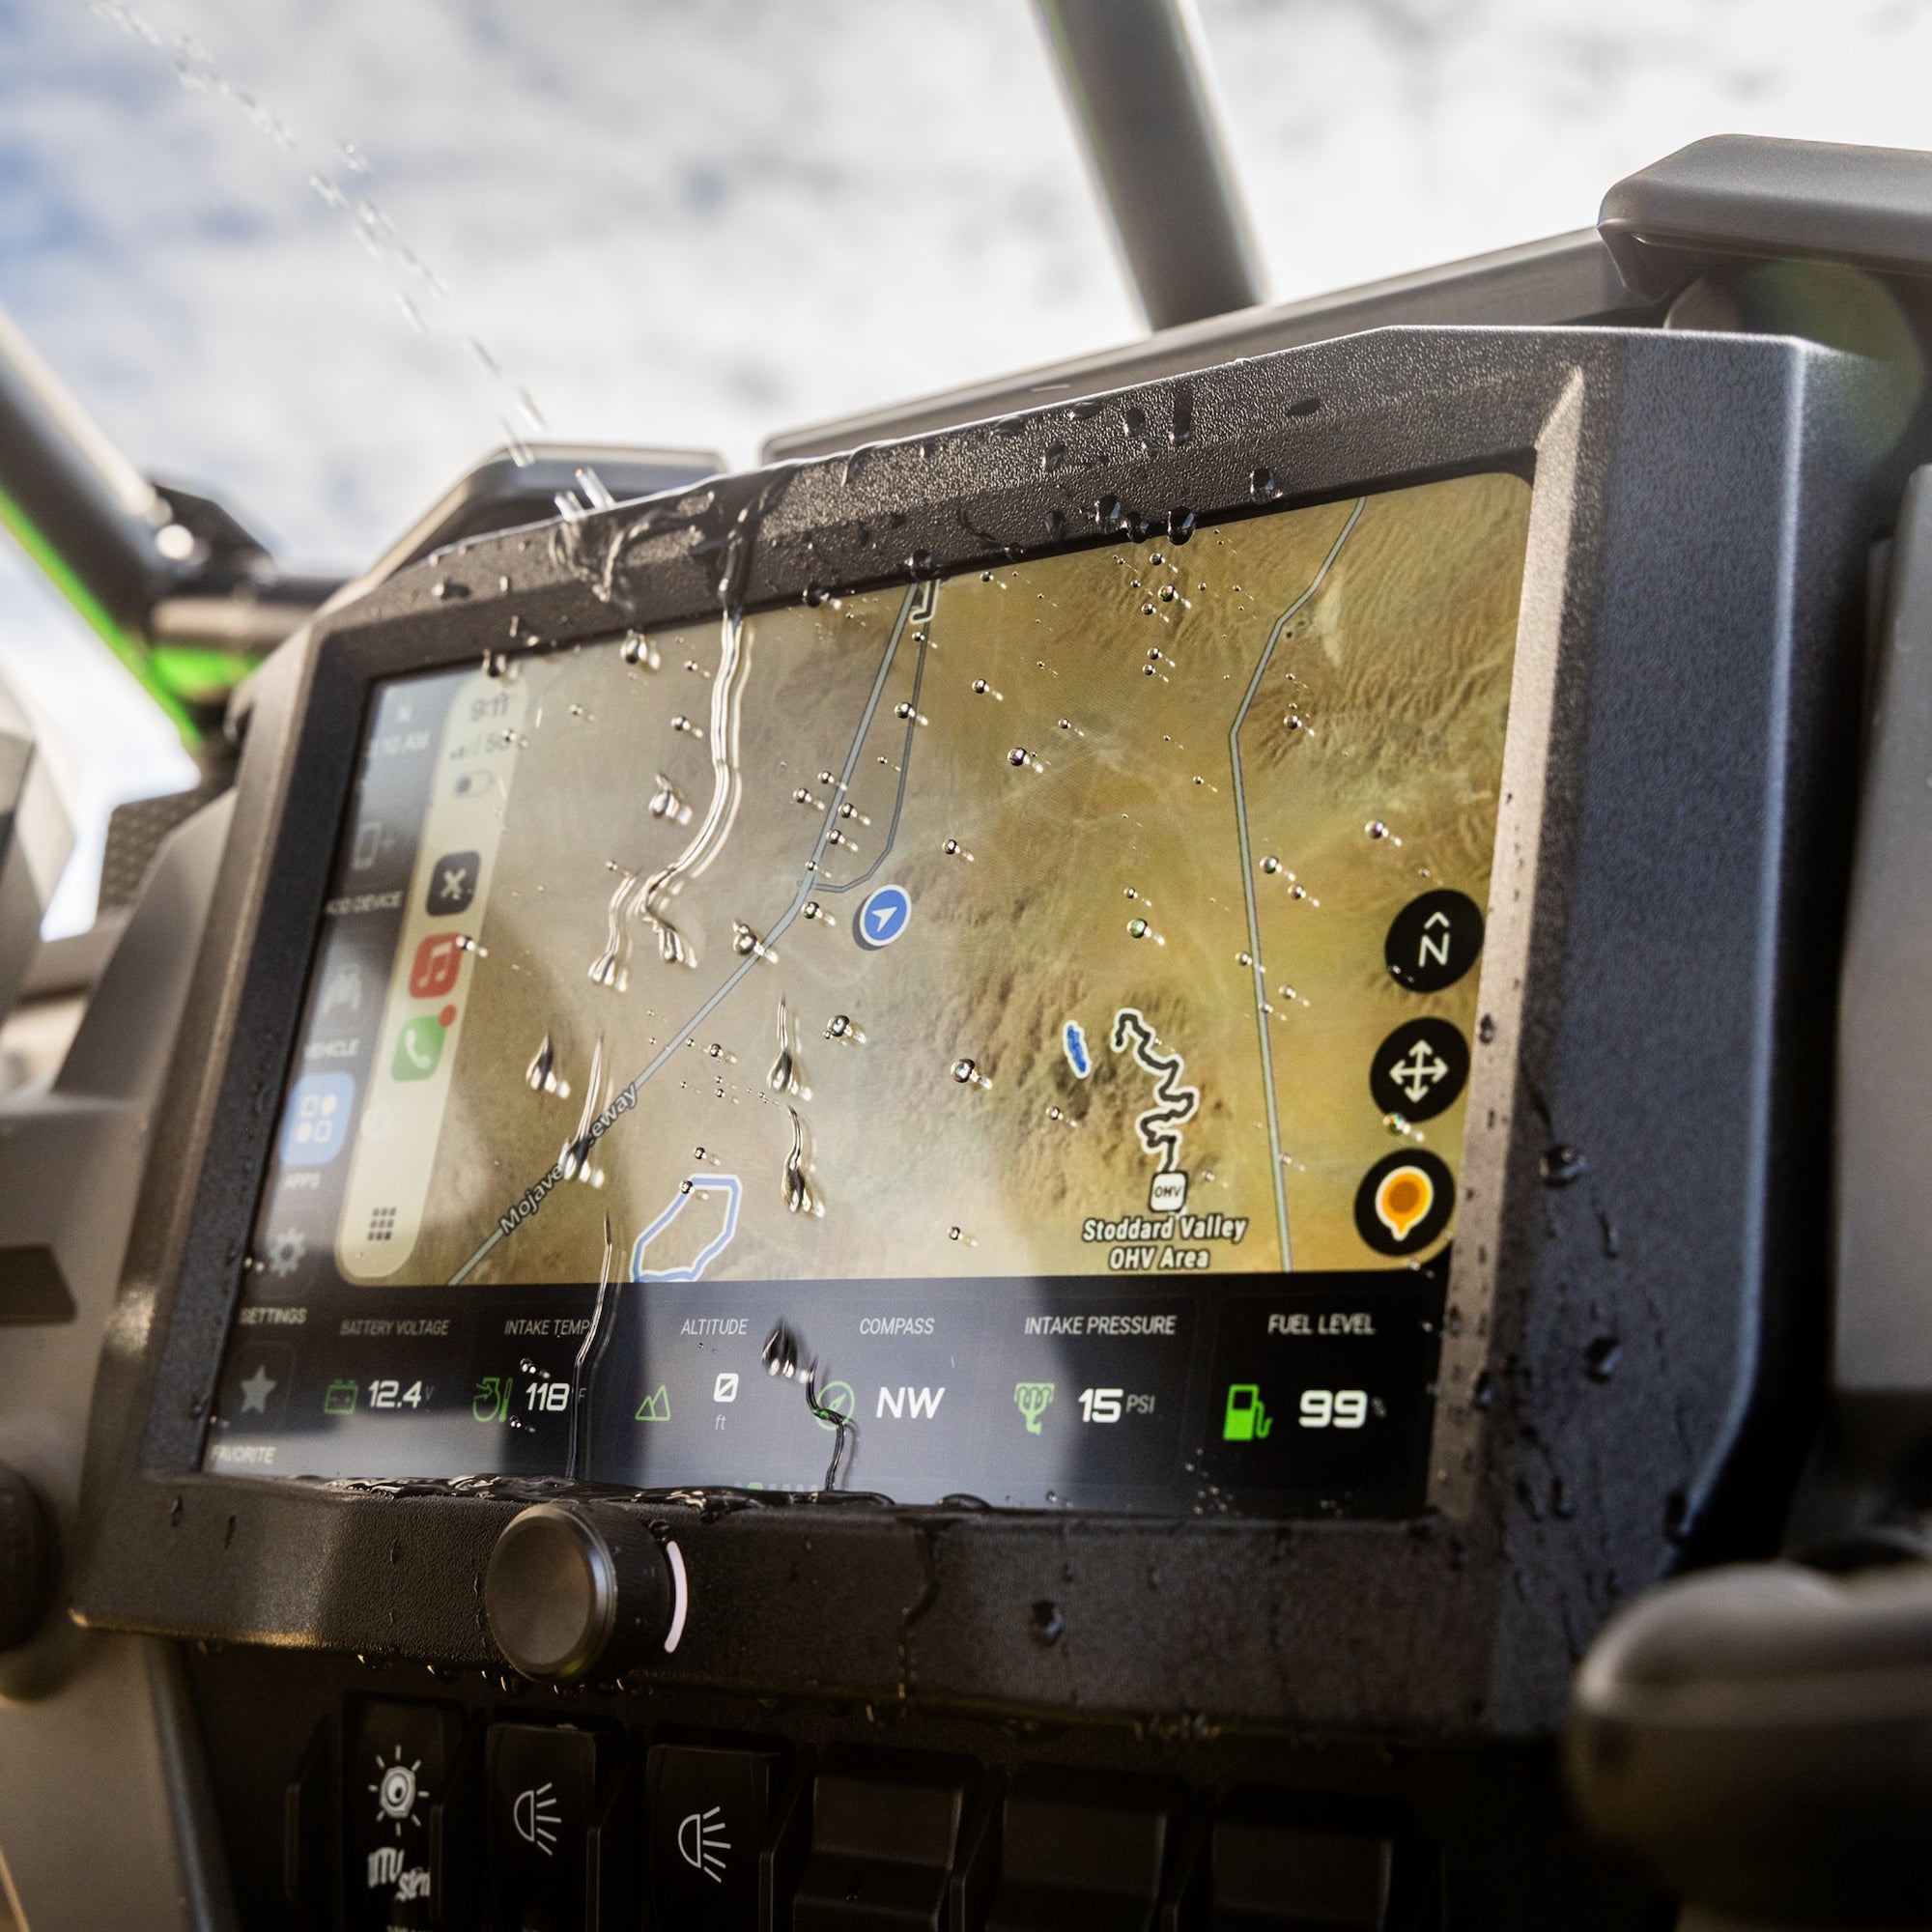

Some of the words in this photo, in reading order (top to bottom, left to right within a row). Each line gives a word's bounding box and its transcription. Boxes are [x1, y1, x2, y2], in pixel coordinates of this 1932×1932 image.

[1154, 1185, 1181, 1198] OHV
[1082, 1215, 1176, 1242] Stoddard
[1180, 1213, 1248, 1243] Valley
[1109, 1246, 1156, 1270] OHV
[1158, 1246, 1210, 1269] Area
[240, 1307, 307, 1324] SETTINGS
[860, 1318, 934, 1335] COMPASS
[1024, 1316, 1084, 1335] INTAKE
[1087, 1315, 1177, 1335] PRESSURE
[1267, 1314, 1312, 1335] FUEL
[1318, 1313, 1376, 1335] LEVEL
[340, 1320, 394, 1336] BATTERY
[396, 1320, 450, 1336] VOLTAGE
[503, 1320, 551, 1336] INTAKE
[554, 1320, 591, 1336] TEMP
[680, 1319, 749, 1335] ALTITUDE
[368, 1379, 422, 1408] 12.4
[526, 1382, 571, 1411] 118
[713, 1373, 739, 1402] 0
[876, 1387, 946, 1419] NW
[1077, 1388, 1124, 1423] 15
[1126, 1394, 1155, 1414] PSI
[1298, 1389, 1368, 1429] 99
[715, 1414, 726, 1431] ft
